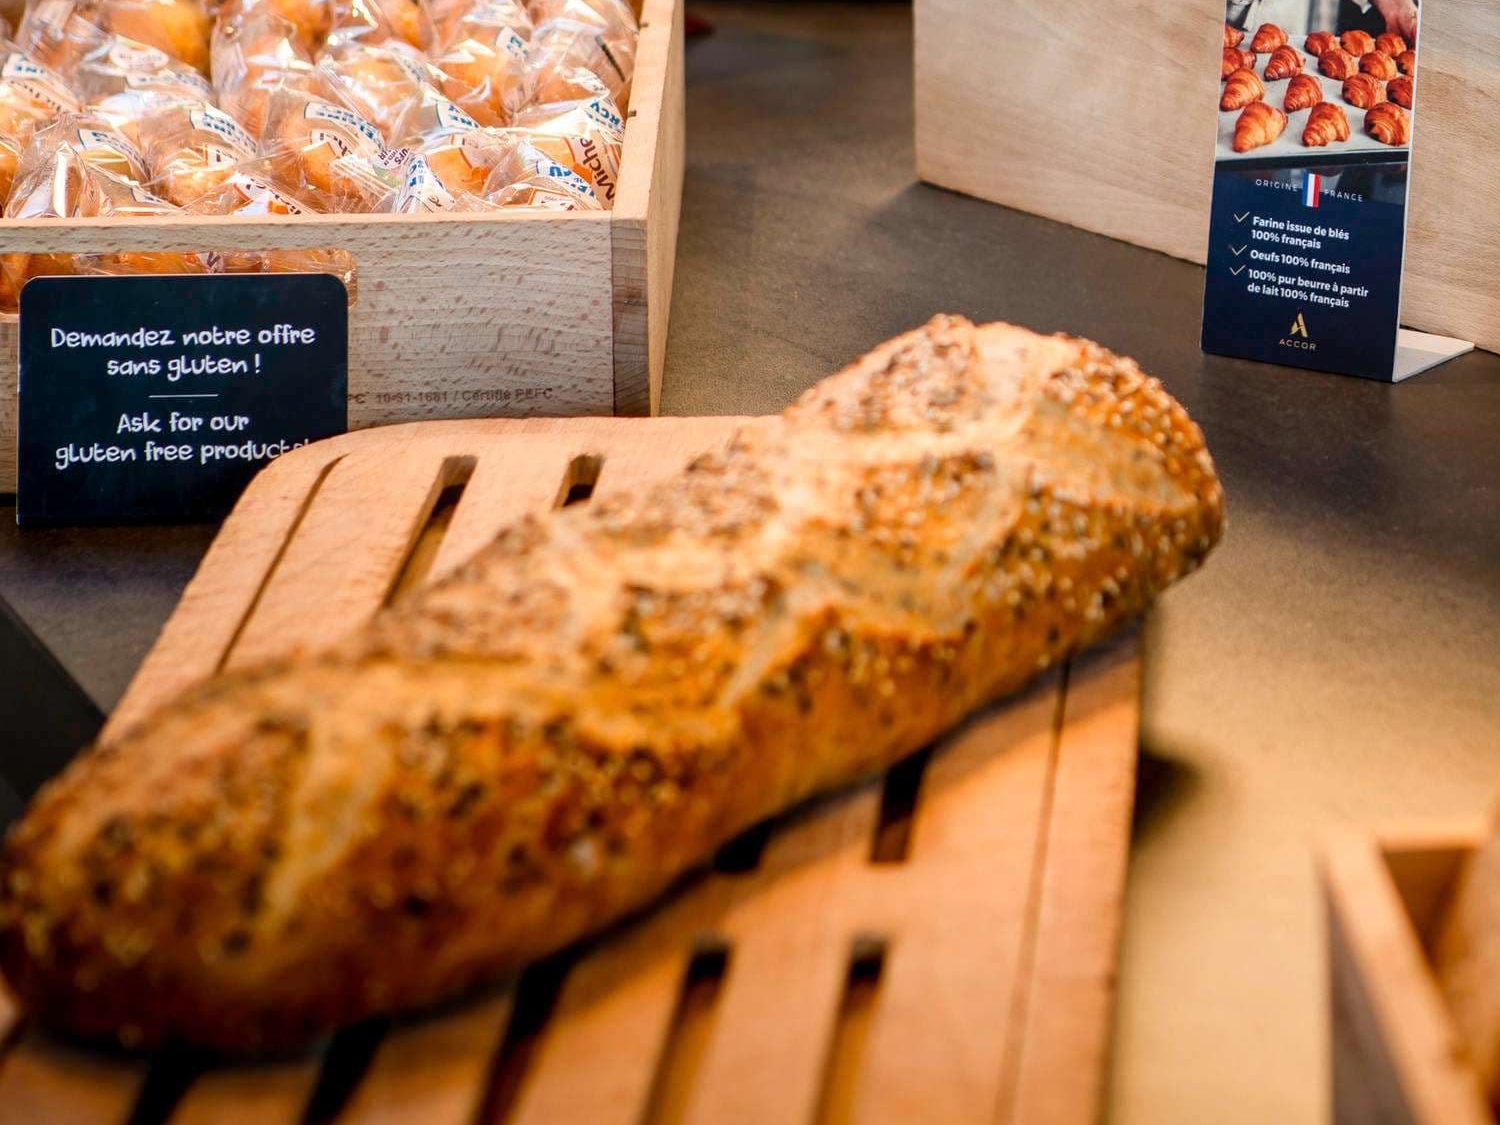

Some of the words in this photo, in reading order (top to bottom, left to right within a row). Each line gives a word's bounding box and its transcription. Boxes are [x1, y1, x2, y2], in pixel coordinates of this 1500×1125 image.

[1255, 178, 1298, 192] ORIGINE
[1323, 188, 1364, 202] FRANCE
[1251, 229, 1280, 243] 100%
[1281, 234, 1322, 250] français
[1252, 215, 1285, 230] Farine
[1286, 220, 1312, 234] issue
[1313, 225, 1327, 236] de
[1328, 227, 1350, 240] blés
[1250, 249, 1280, 263] Oeufs
[1281, 253, 1309, 268] 100%
[1310, 258, 1350, 274] français
[1247, 282, 1261, 294] de
[1262, 284, 1279, 296] lait
[1280, 287, 1309, 301] 100%
[1309, 291, 1350, 308] français
[1248, 269, 1277, 282] 100%
[1278, 274, 1296, 286] pur
[1297, 276, 1331, 291] beurre
[1340, 284, 1369, 298] partir
[51, 327, 176, 349] Demandez
[182, 325, 251, 347] notre
[257, 324, 316, 345] offre
[1279, 338, 1317, 351] ACCOR
[107, 357, 161, 376] sans
[167, 353, 248, 382] gluten
[116, 411, 162, 435] Ask
[169, 411, 204, 433] for
[210, 414, 249, 432] our
[54, 440, 137, 470] gluten
[144, 440, 194, 462] free
